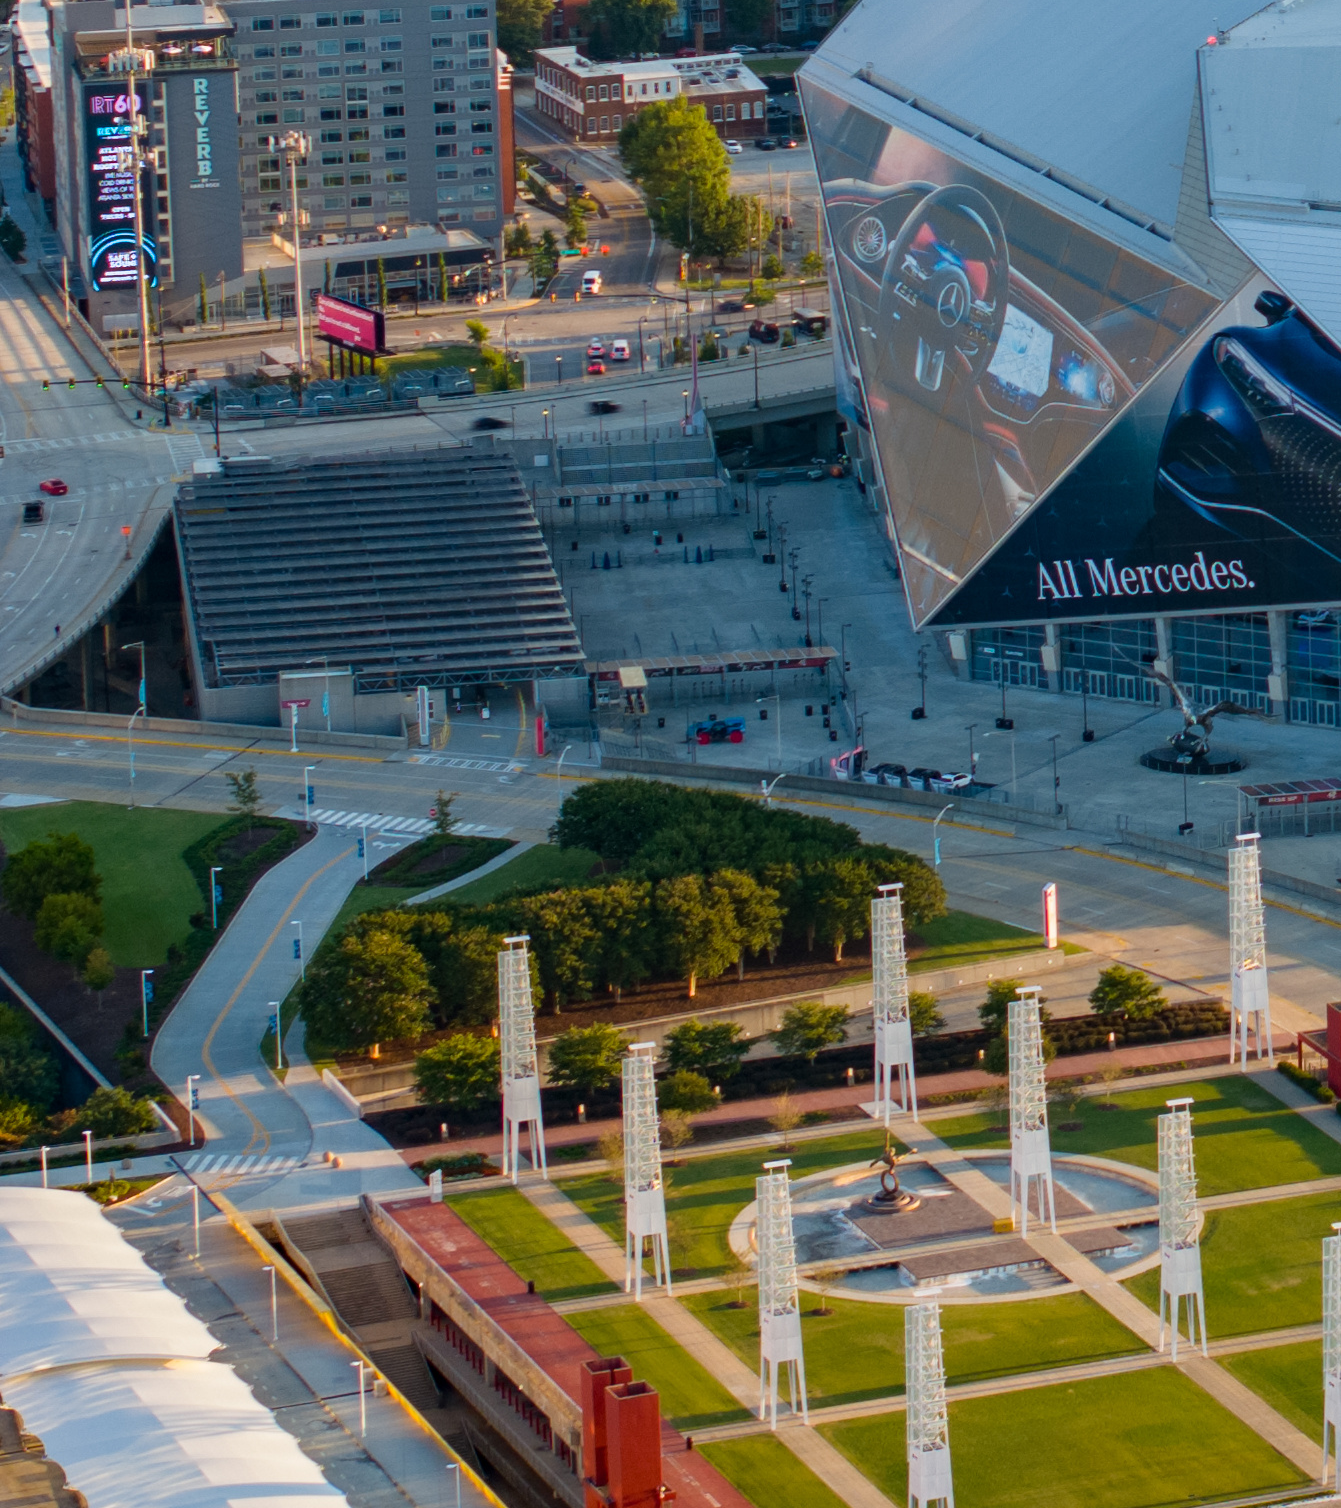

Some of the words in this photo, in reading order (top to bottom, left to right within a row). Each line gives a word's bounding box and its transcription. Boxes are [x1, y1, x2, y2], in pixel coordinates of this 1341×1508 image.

[90, 94, 142, 114] RT60
[193, 78, 213, 176] REVERB
[1037, 559, 1082, 600] All
[1084, 551, 1256, 597] Mercedes.
